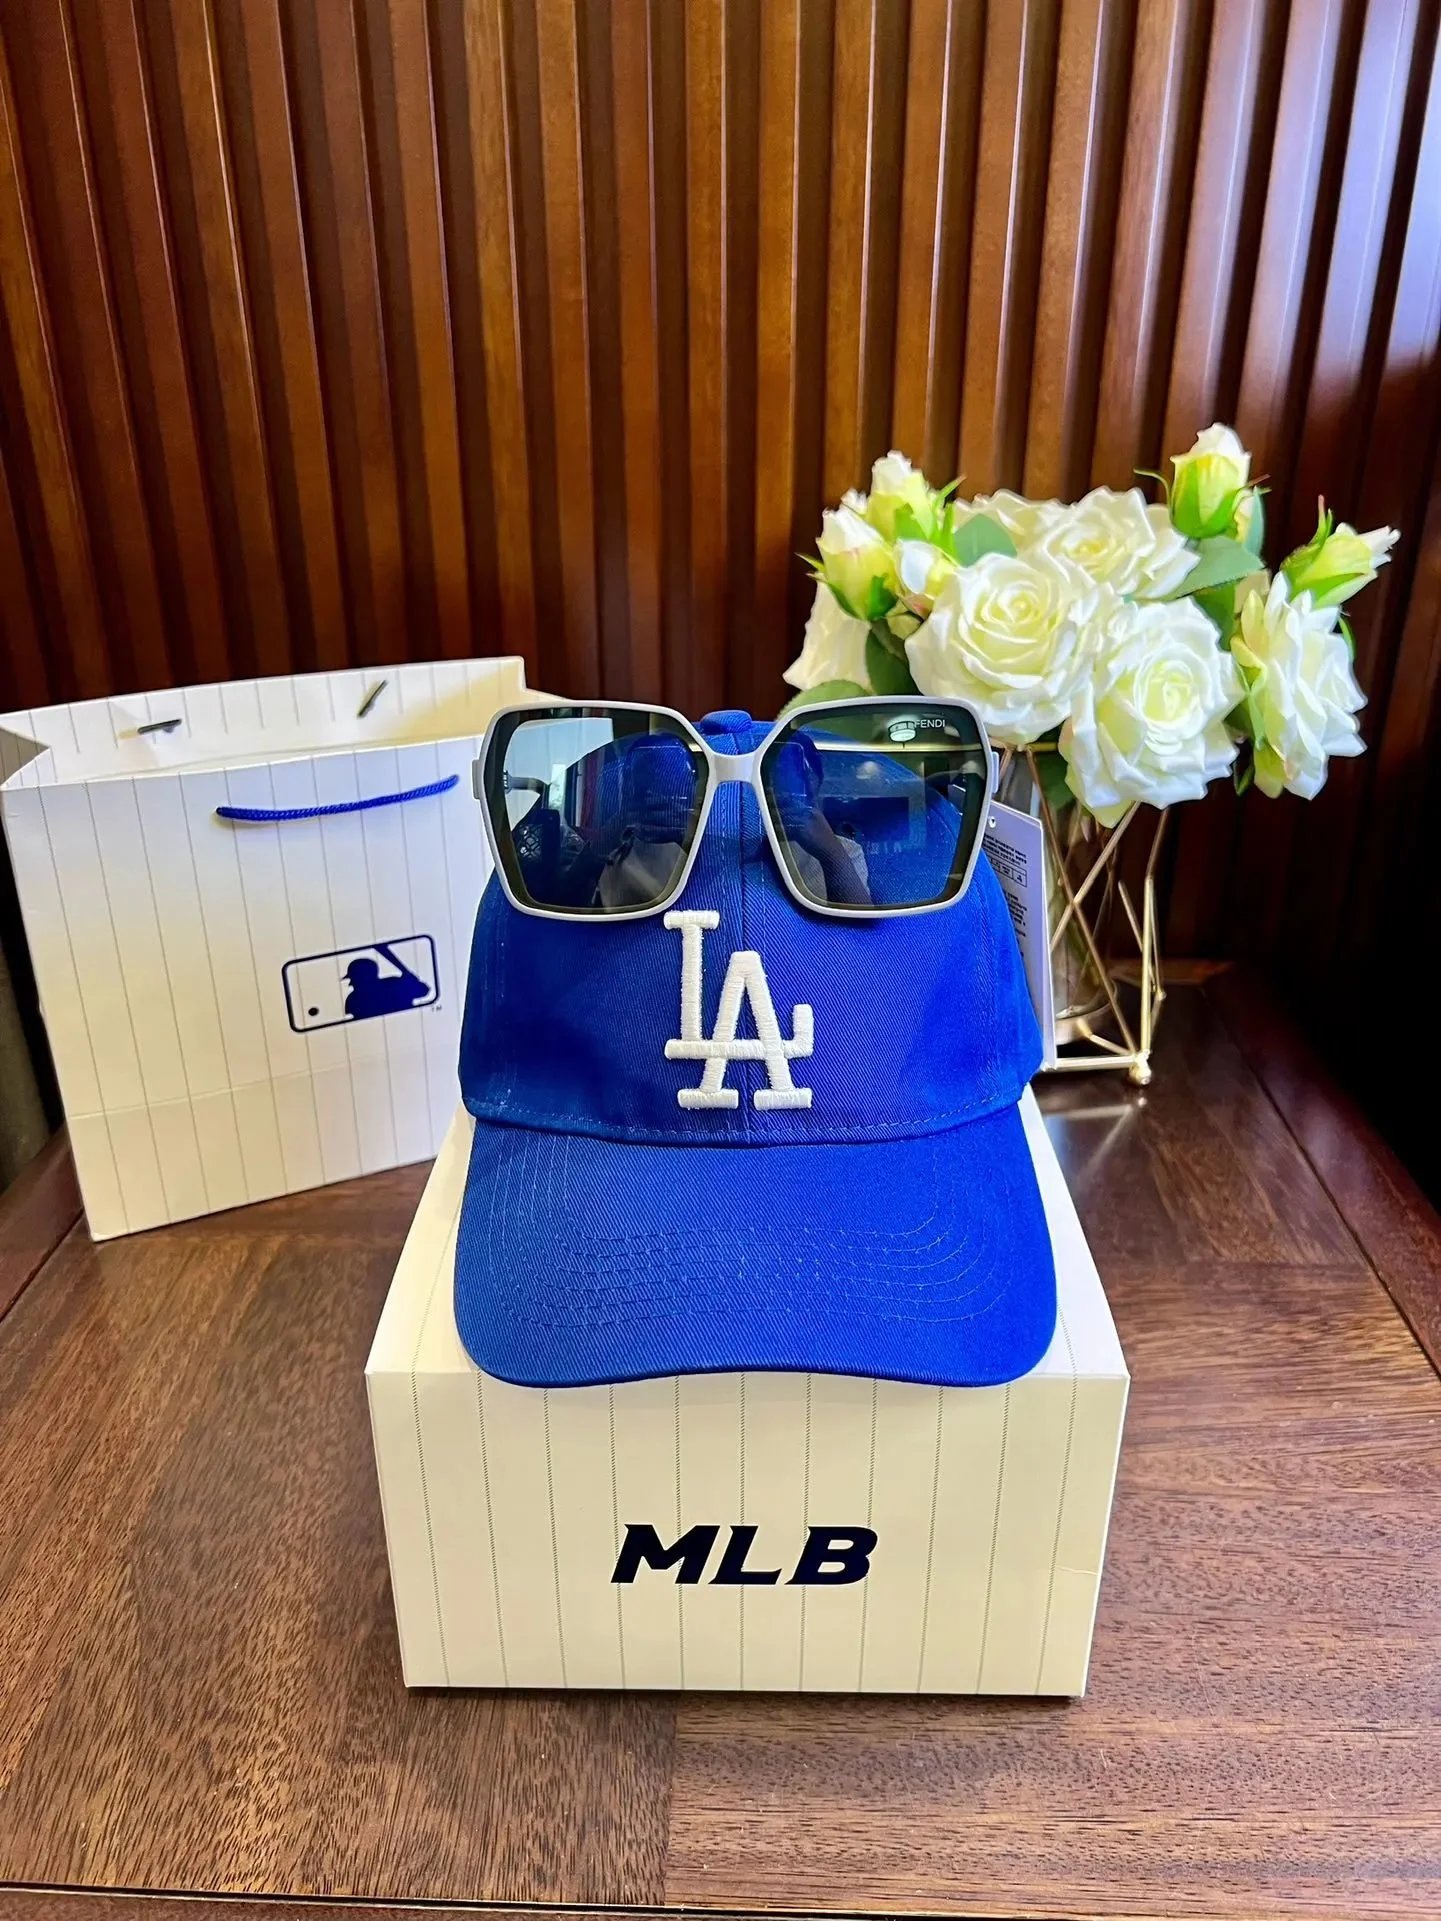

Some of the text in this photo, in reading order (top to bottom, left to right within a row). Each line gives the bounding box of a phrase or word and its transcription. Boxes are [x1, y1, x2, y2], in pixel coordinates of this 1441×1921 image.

[914, 719, 946, 728] FENDI
[663, 910, 815, 1111] LA
[610, 1523, 878, 1585] MLB
